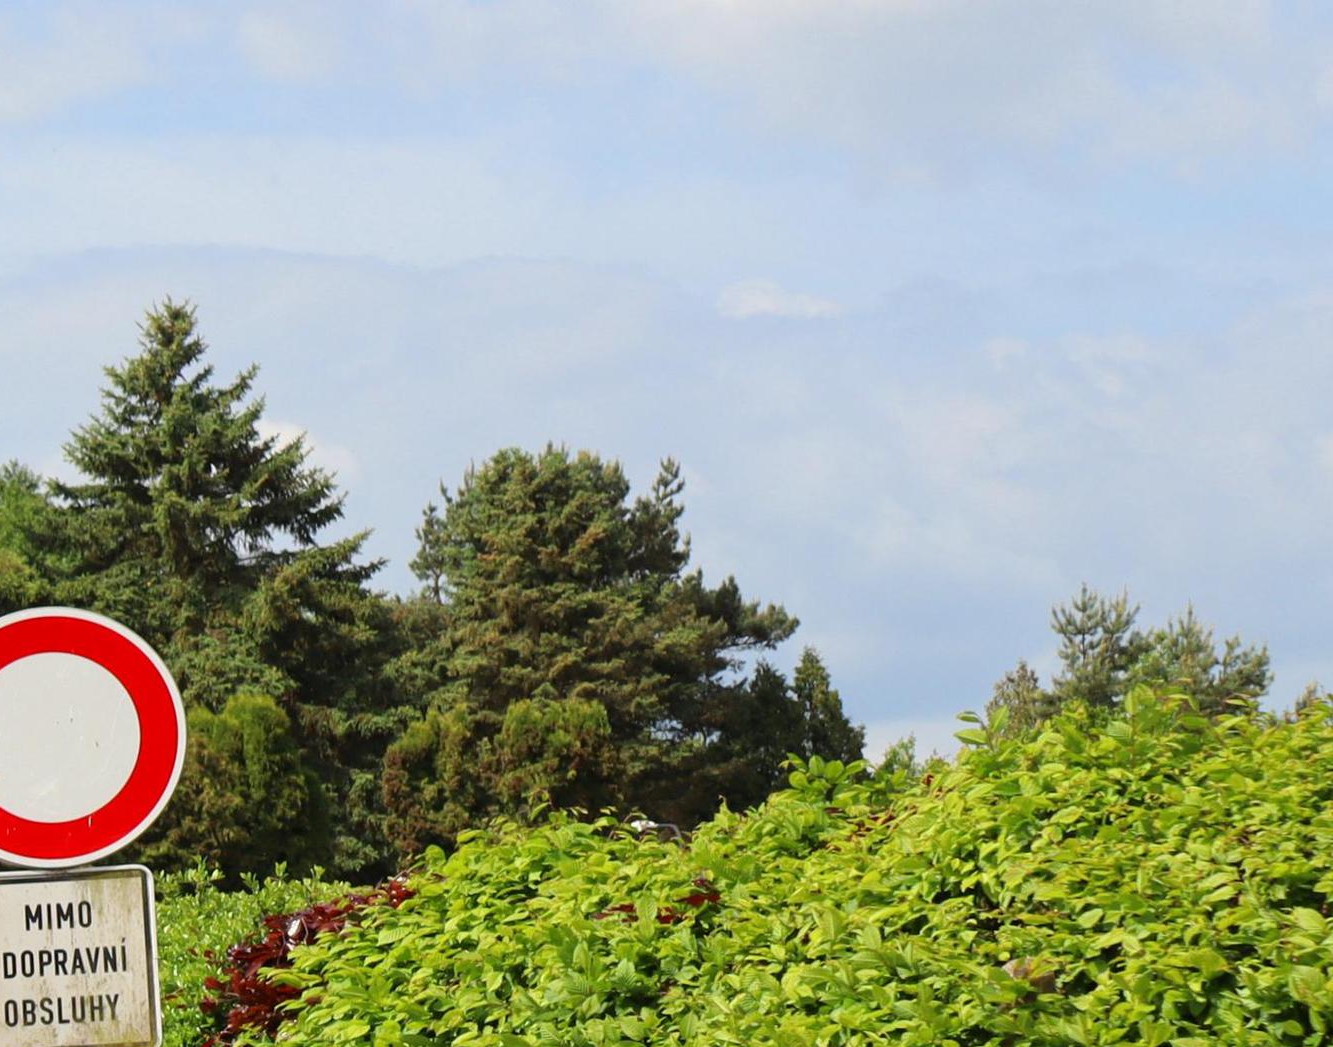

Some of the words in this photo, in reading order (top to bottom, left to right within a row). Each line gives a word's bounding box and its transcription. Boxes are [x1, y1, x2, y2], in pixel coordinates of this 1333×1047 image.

[24, 901, 92, 931] MIMO
[2, 937, 127, 979] DOPRAVNÍ
[4, 993, 120, 1027] OBSLUHY
